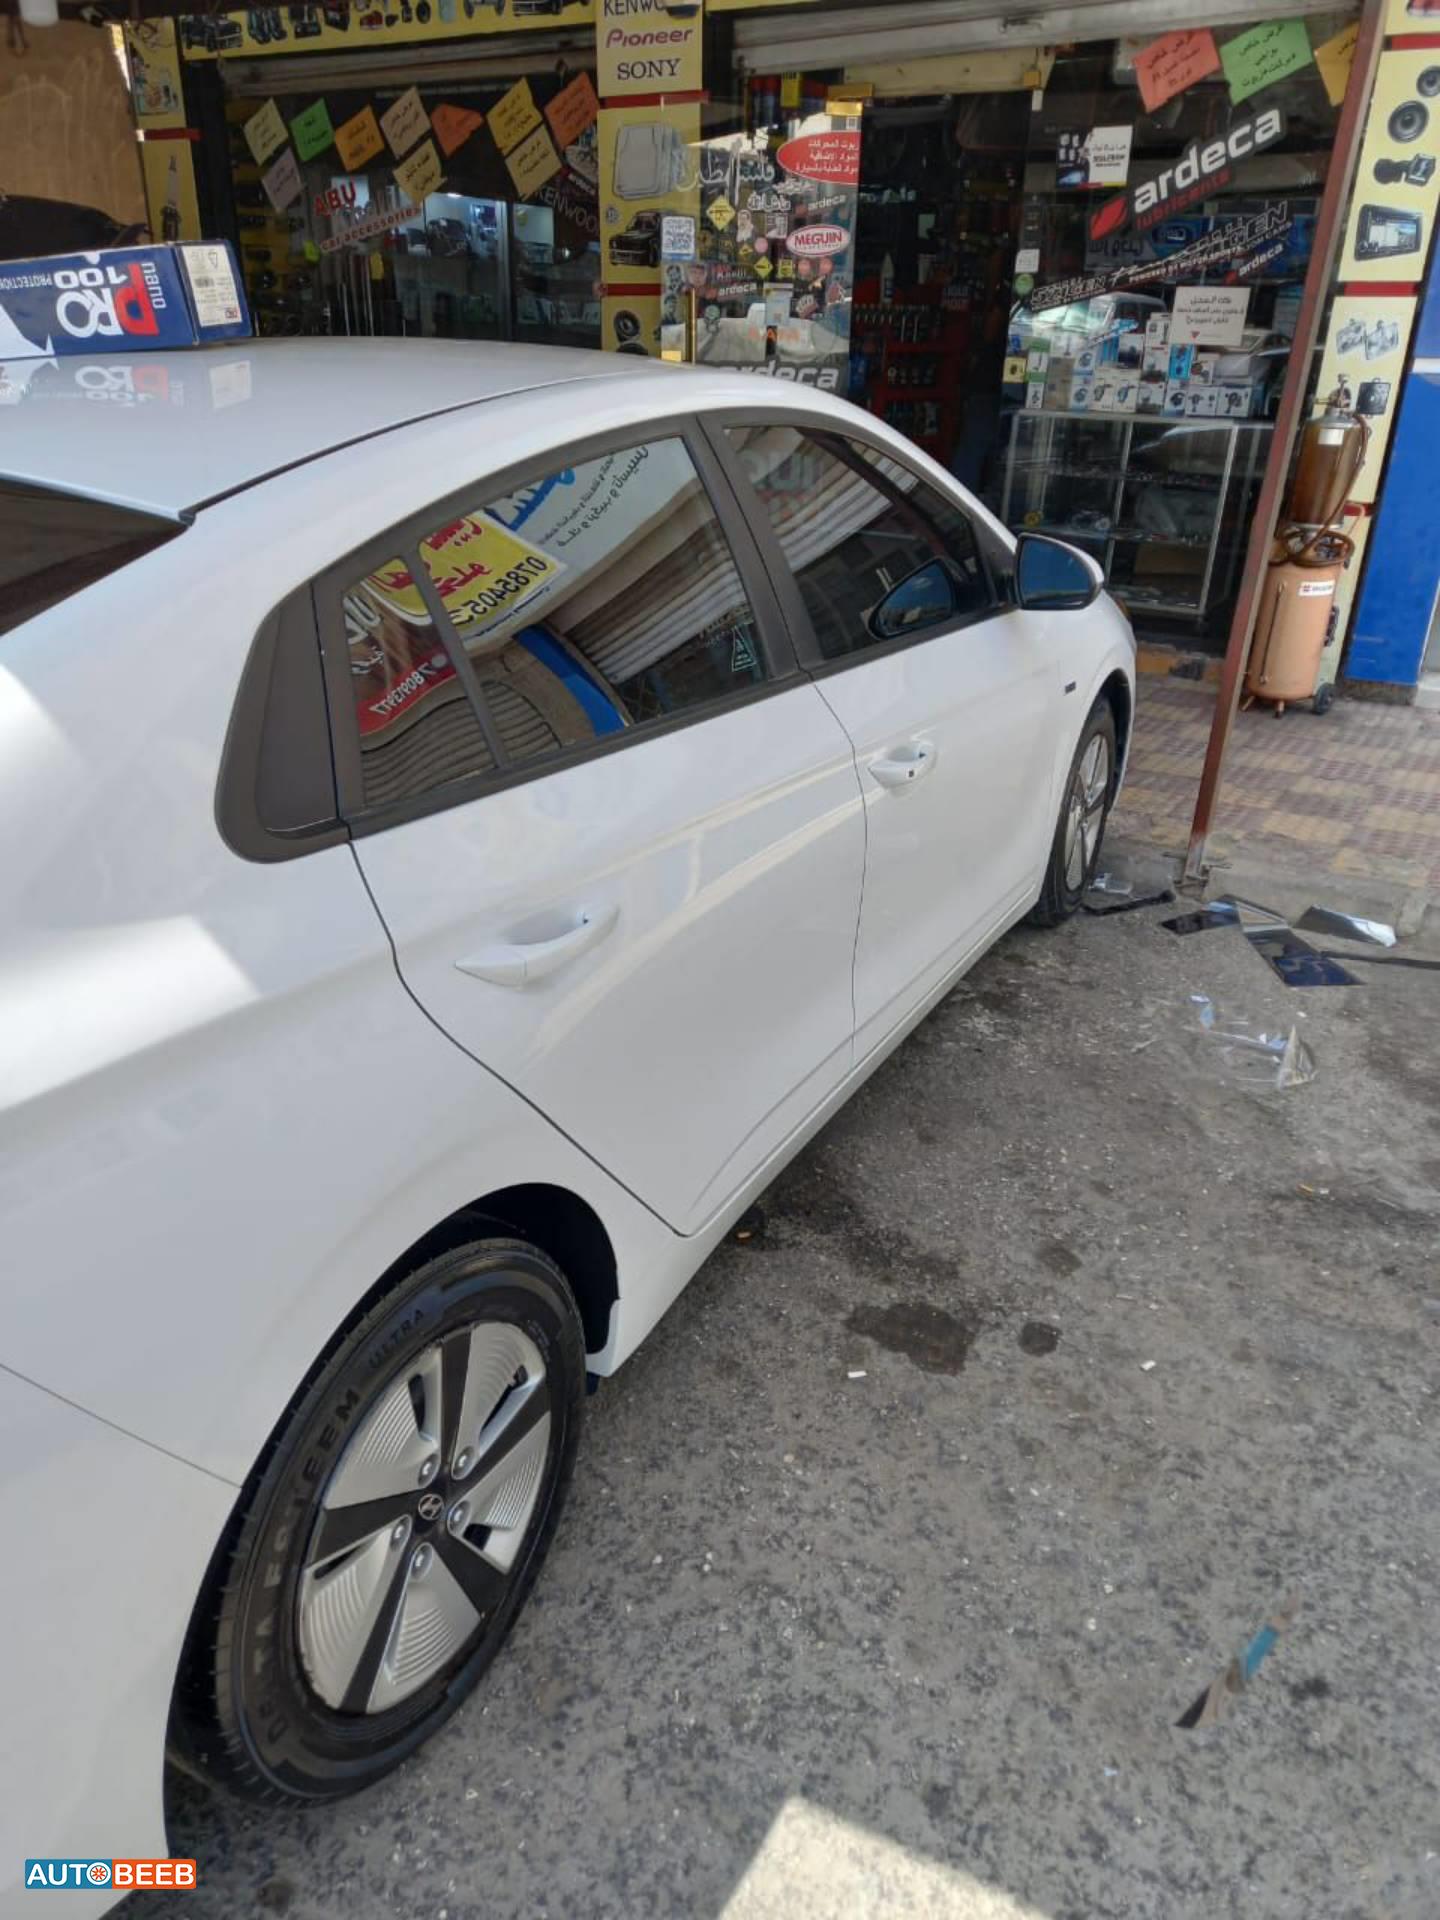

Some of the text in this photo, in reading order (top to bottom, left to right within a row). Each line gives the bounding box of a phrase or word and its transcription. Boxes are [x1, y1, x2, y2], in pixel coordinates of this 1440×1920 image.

[606, 28, 694, 48] Pioneer
[617, 58, 682, 80] SONY
[1134, 107, 1282, 213] ardeca
[808, 194, 846, 211] ardeca
[344, 207, 422, 242] accessories
[795, 231, 842, 246] MEGUIN
[1238, 243, 1284, 277] ardeca
[54, 266, 128, 289] 100
[142, 261, 167, 310] nano
[718, 281, 757, 297] ardeca
[56, 263, 159, 338] PRO
